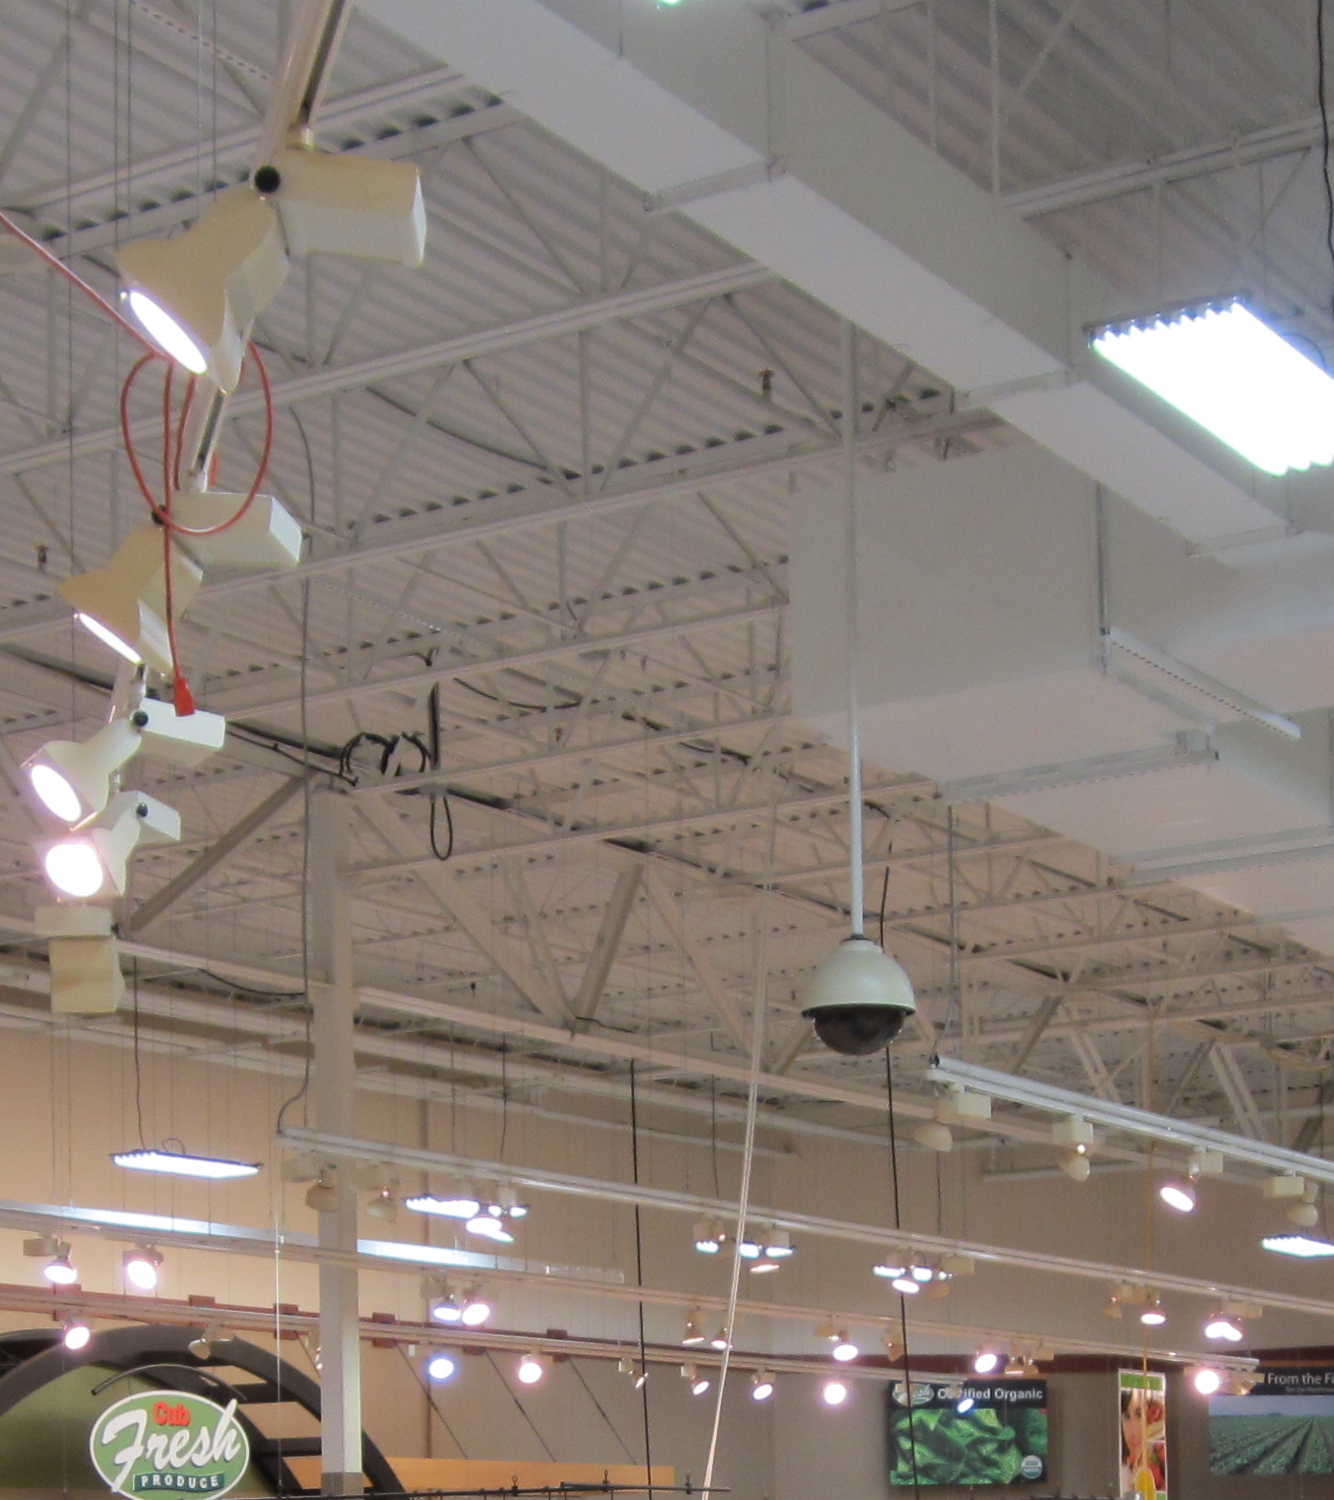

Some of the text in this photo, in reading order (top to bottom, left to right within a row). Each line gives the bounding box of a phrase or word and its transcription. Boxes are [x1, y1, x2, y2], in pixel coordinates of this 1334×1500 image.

[1267, 1372, 1299, 1385] From
[1302, 1372, 1322, 1385] the
[994, 1387, 1044, 1402] Organic
[152, 1401, 192, 1427] Cub
[102, 1398, 242, 1493] Fresh
[141, 1474, 219, 1489] PRODUCE
